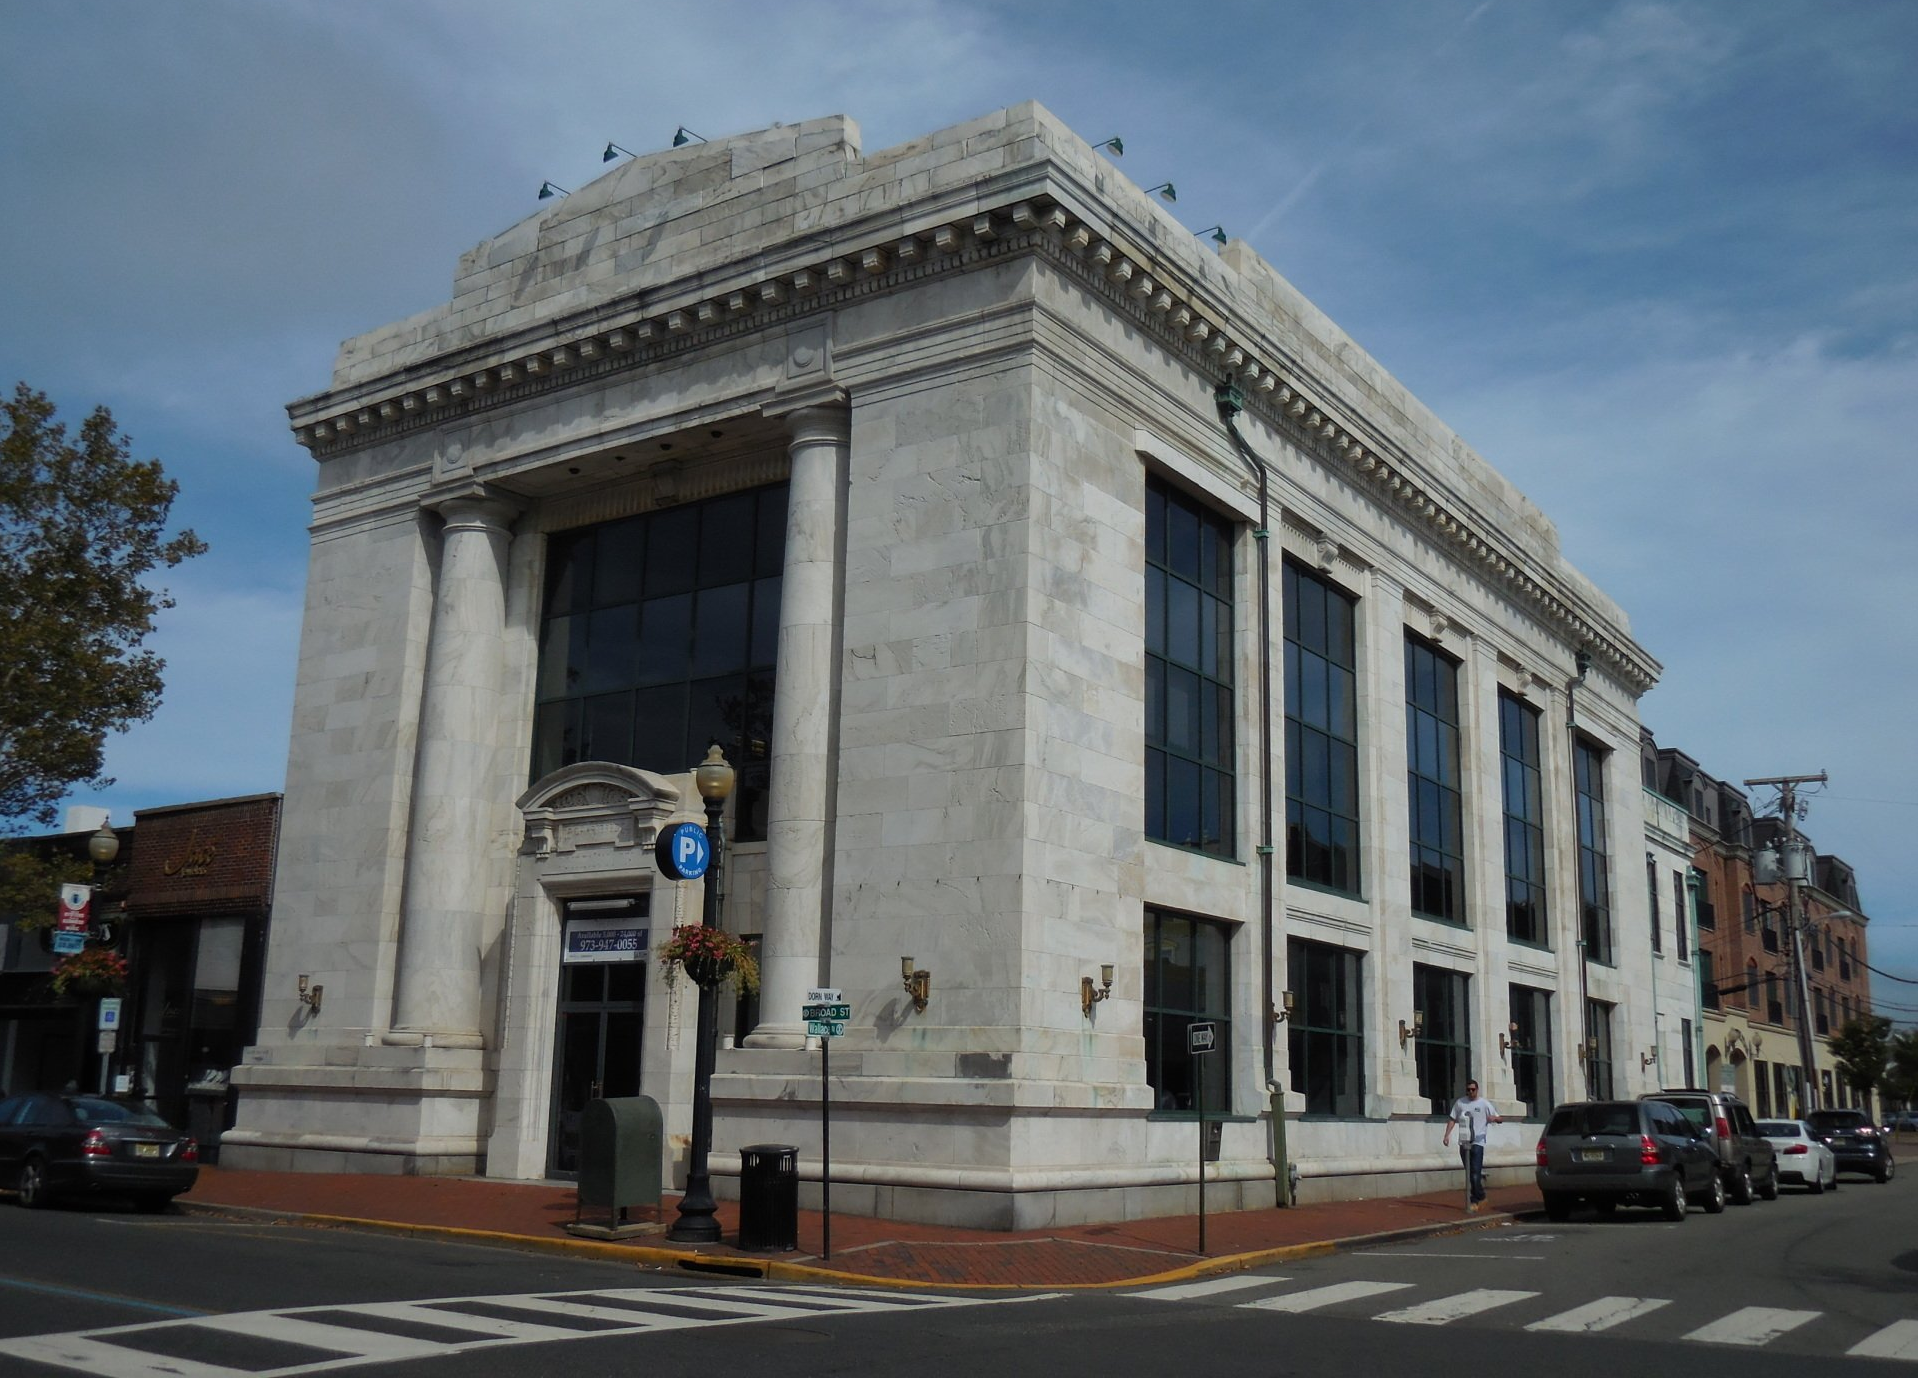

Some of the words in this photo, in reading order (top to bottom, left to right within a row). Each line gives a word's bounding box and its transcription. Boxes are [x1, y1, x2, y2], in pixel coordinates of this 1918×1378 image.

[680, 826, 703, 839] PUBLIC
[680, 836, 696, 863] P
[678, 864, 702, 876] PARKING
[577, 931, 602, 939] Available
[580, 938, 638, 951] 973-947-0055
[808, 992, 822, 1001] DORN
[823, 992, 834, 1001] WAY
[810, 1007, 837, 1018] BROAD
[839, 1007, 850, 1017] ST
[809, 1022, 830, 1034] Wallace
